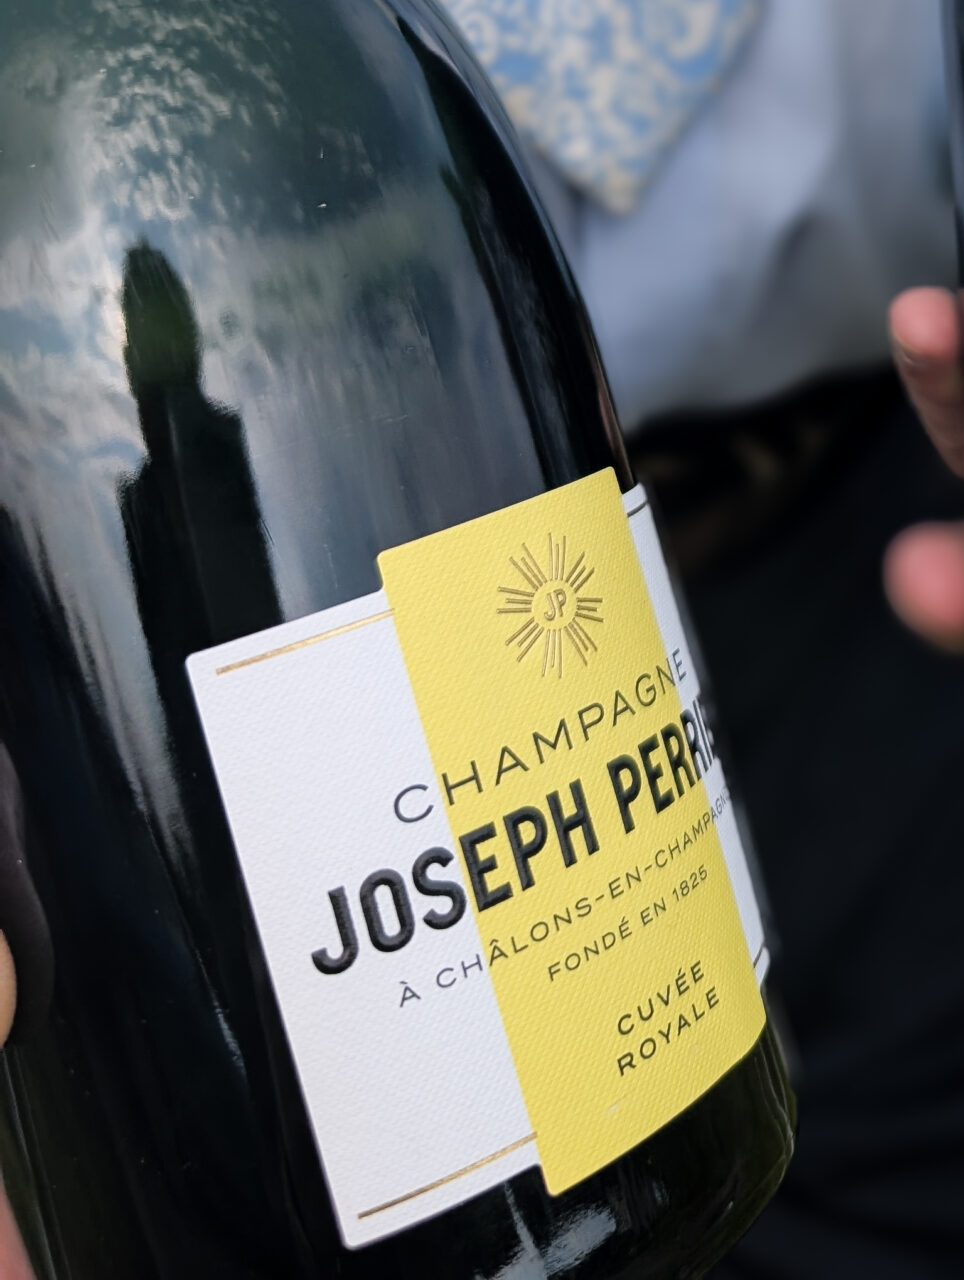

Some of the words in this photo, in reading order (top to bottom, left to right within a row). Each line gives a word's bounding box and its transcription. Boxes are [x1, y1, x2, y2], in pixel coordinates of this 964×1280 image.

[544, 587, 567, 621] JP
[393, 647, 687, 824] CHAMPAGNE
[310, 777, 601, 976] JOSEPH
[606, 694, 715, 835] PERRI
[399, 980, 422, 1009] À
[435, 786, 731, 989] CHÂLONS-EN-CHAMPAGN
[547, 916, 633, 982] FONDÉ
[639, 897, 667, 927] EN
[672, 863, 709, 903] 1825
[616, 958, 705, 1036] CUVÉE
[616, 985, 720, 1077] ROYALE
